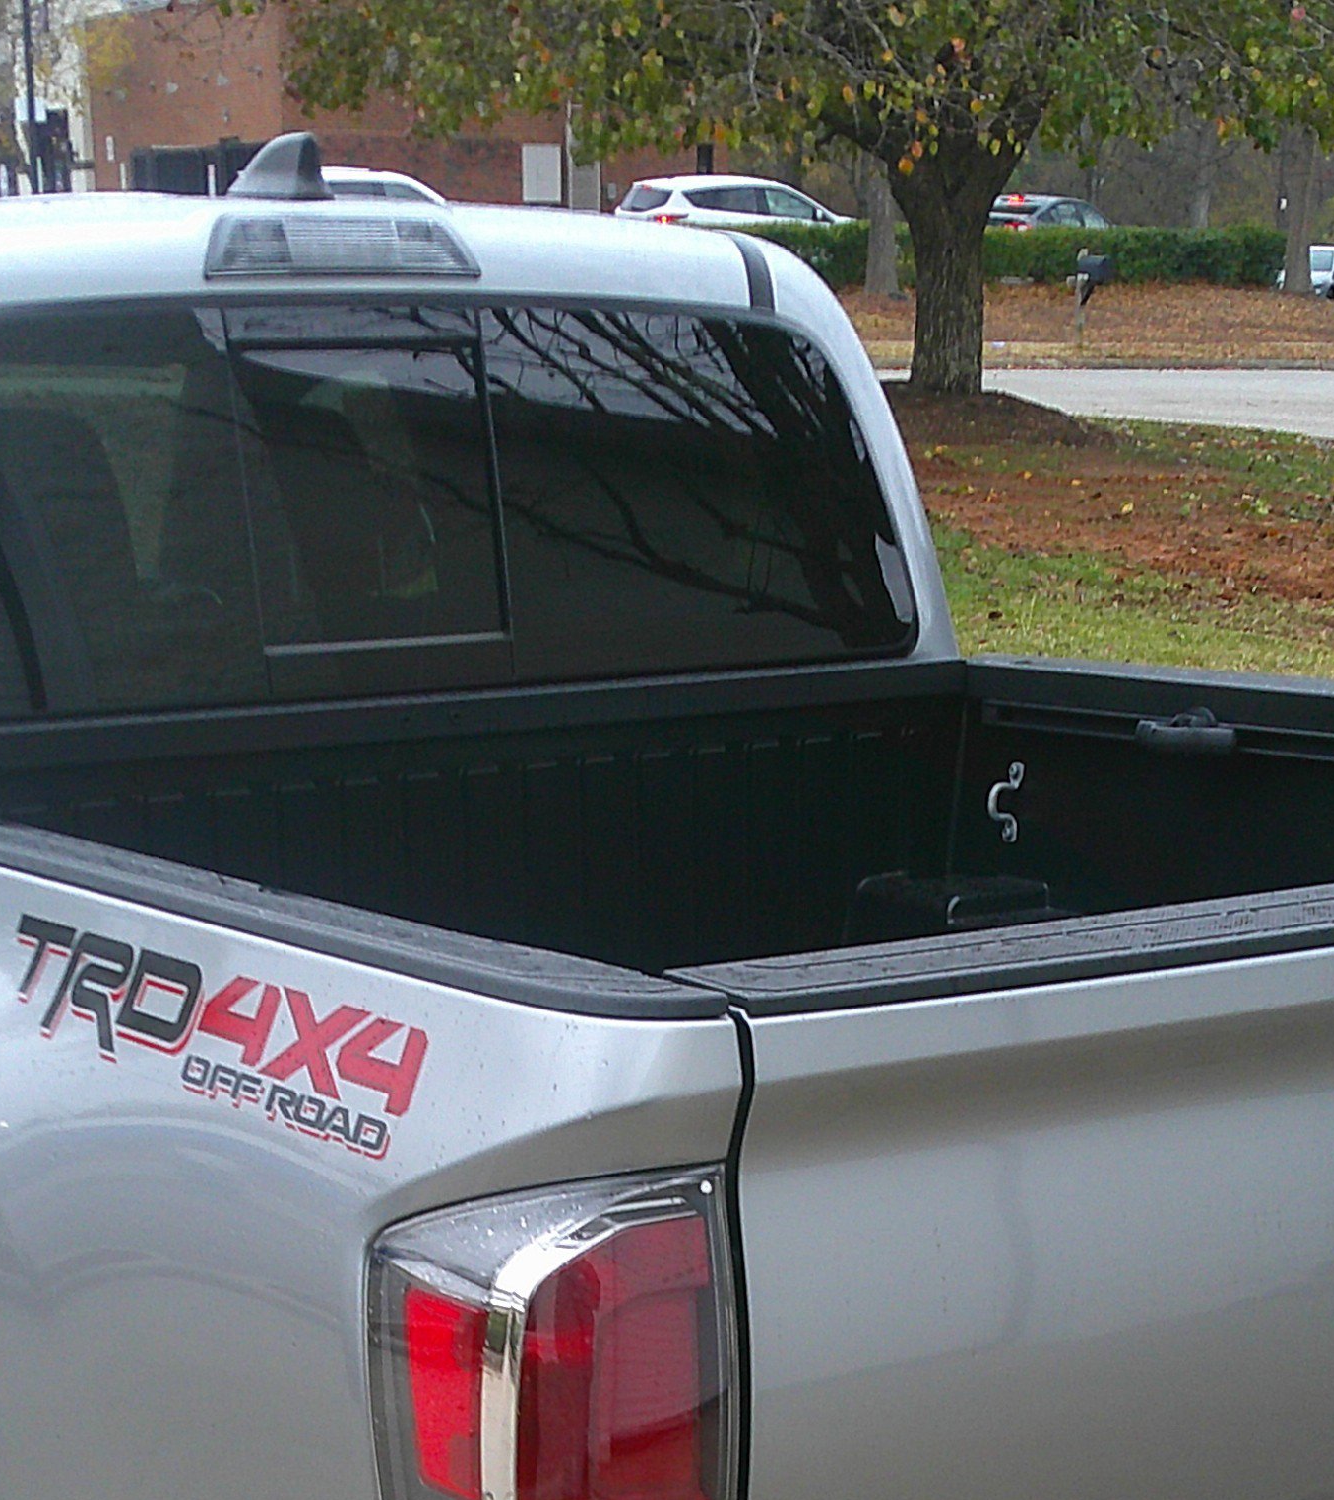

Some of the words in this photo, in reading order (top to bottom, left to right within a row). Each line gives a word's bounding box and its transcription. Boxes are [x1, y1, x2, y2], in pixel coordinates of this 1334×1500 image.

[16, 913, 205, 1063] TRD
[181, 1055, 266, 1108] OFF
[266, 1084, 392, 1161] ROAD
